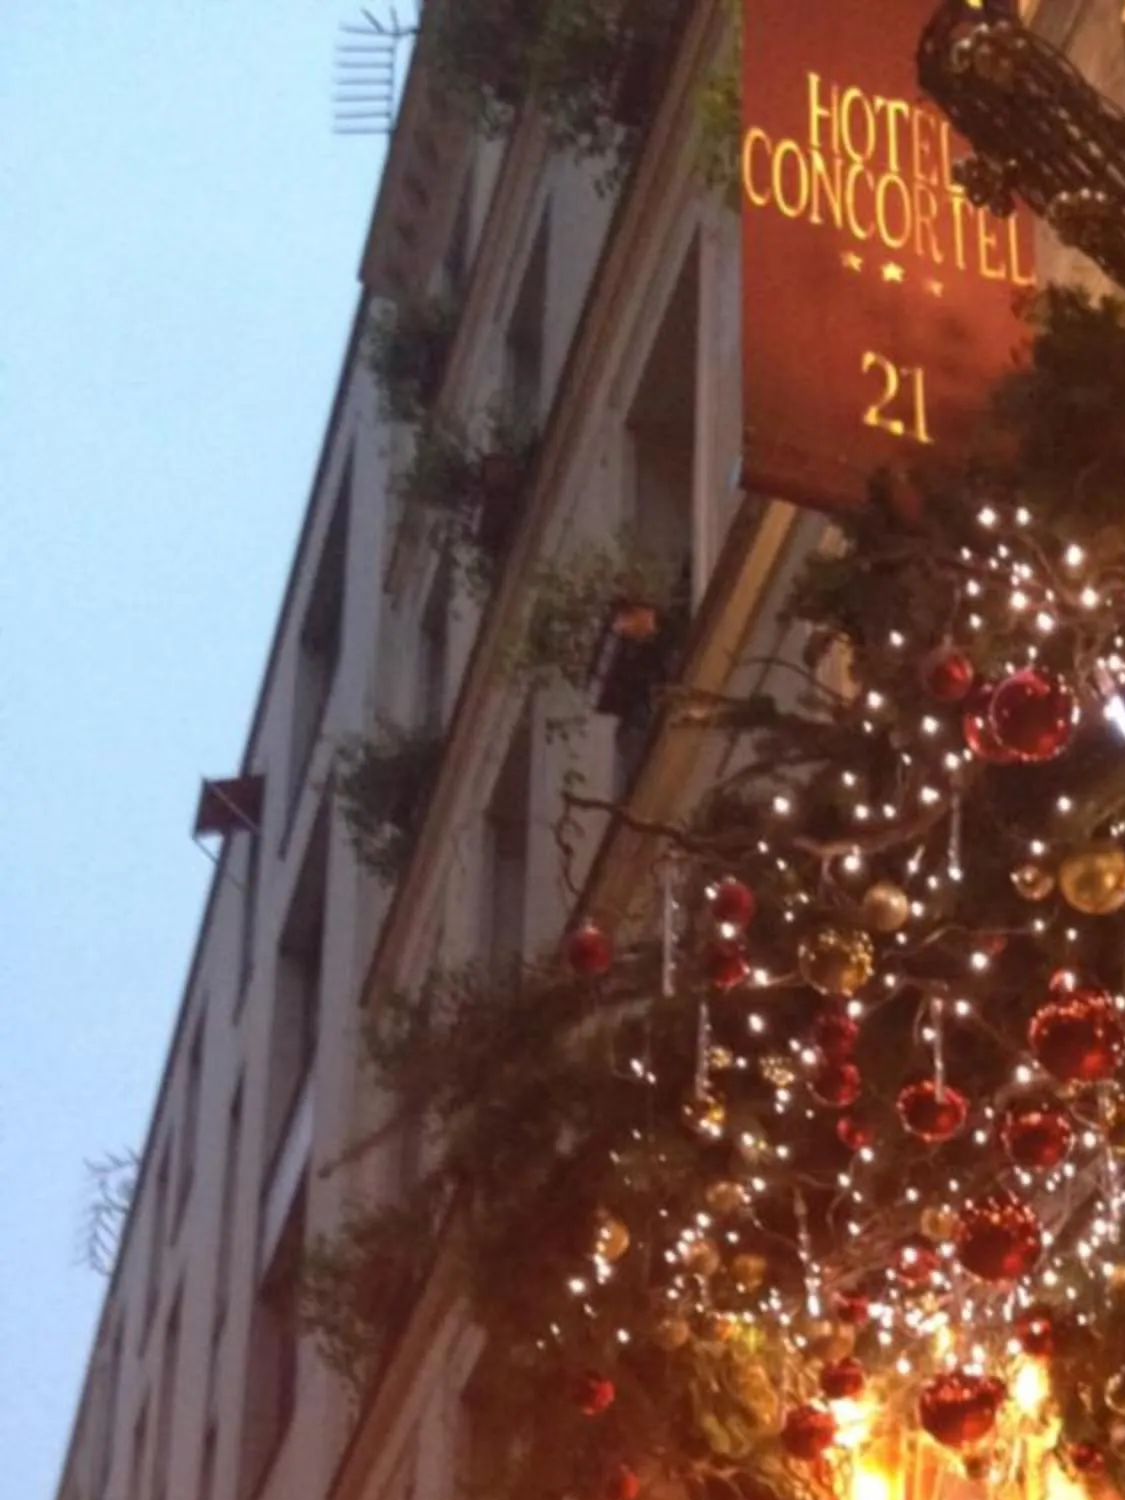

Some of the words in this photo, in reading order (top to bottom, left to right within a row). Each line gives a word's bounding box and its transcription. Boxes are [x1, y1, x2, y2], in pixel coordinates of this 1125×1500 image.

[808, 71, 966, 194] HOTEL
[743, 127, 1037, 285] CONCORTEL
[862, 351, 933, 444] 21
